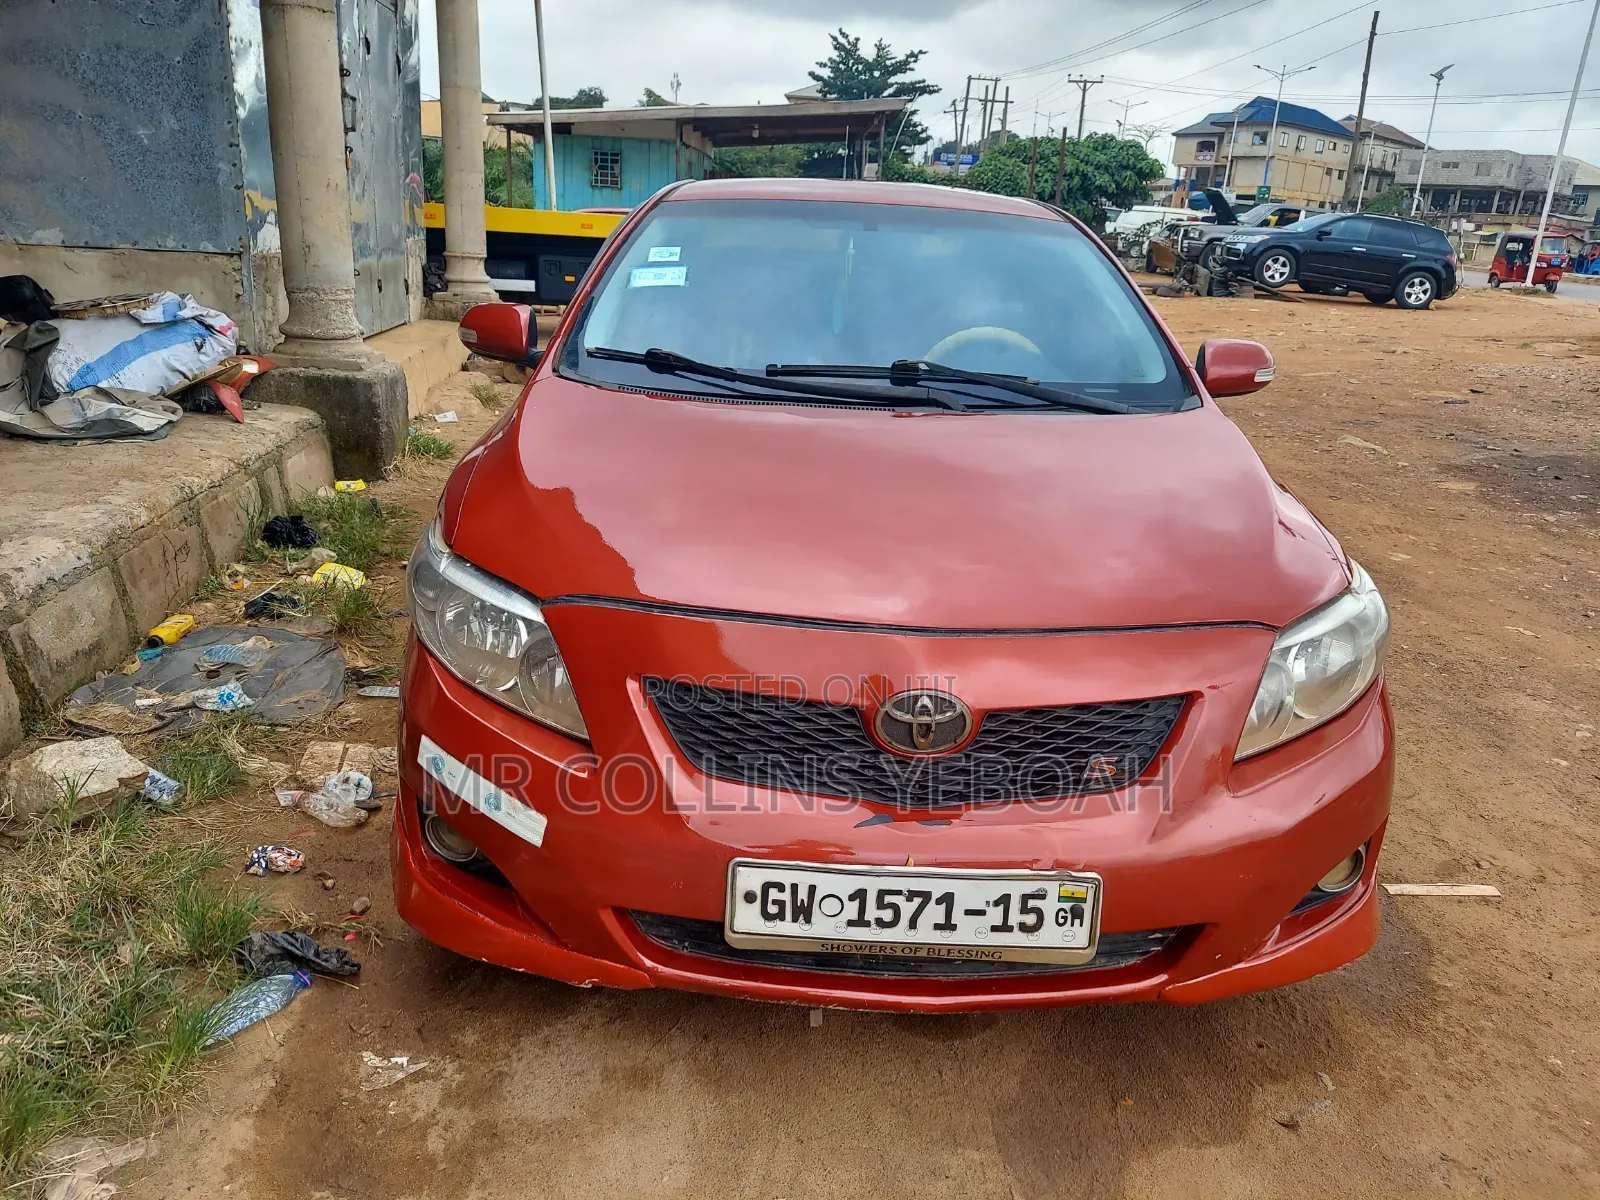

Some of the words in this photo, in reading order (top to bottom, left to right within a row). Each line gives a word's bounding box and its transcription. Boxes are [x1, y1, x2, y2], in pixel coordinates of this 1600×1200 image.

[820, 943, 898, 955] SHOWERS
[900, 945, 923, 956] OF
[926, 947, 1003, 960] BLESSING
